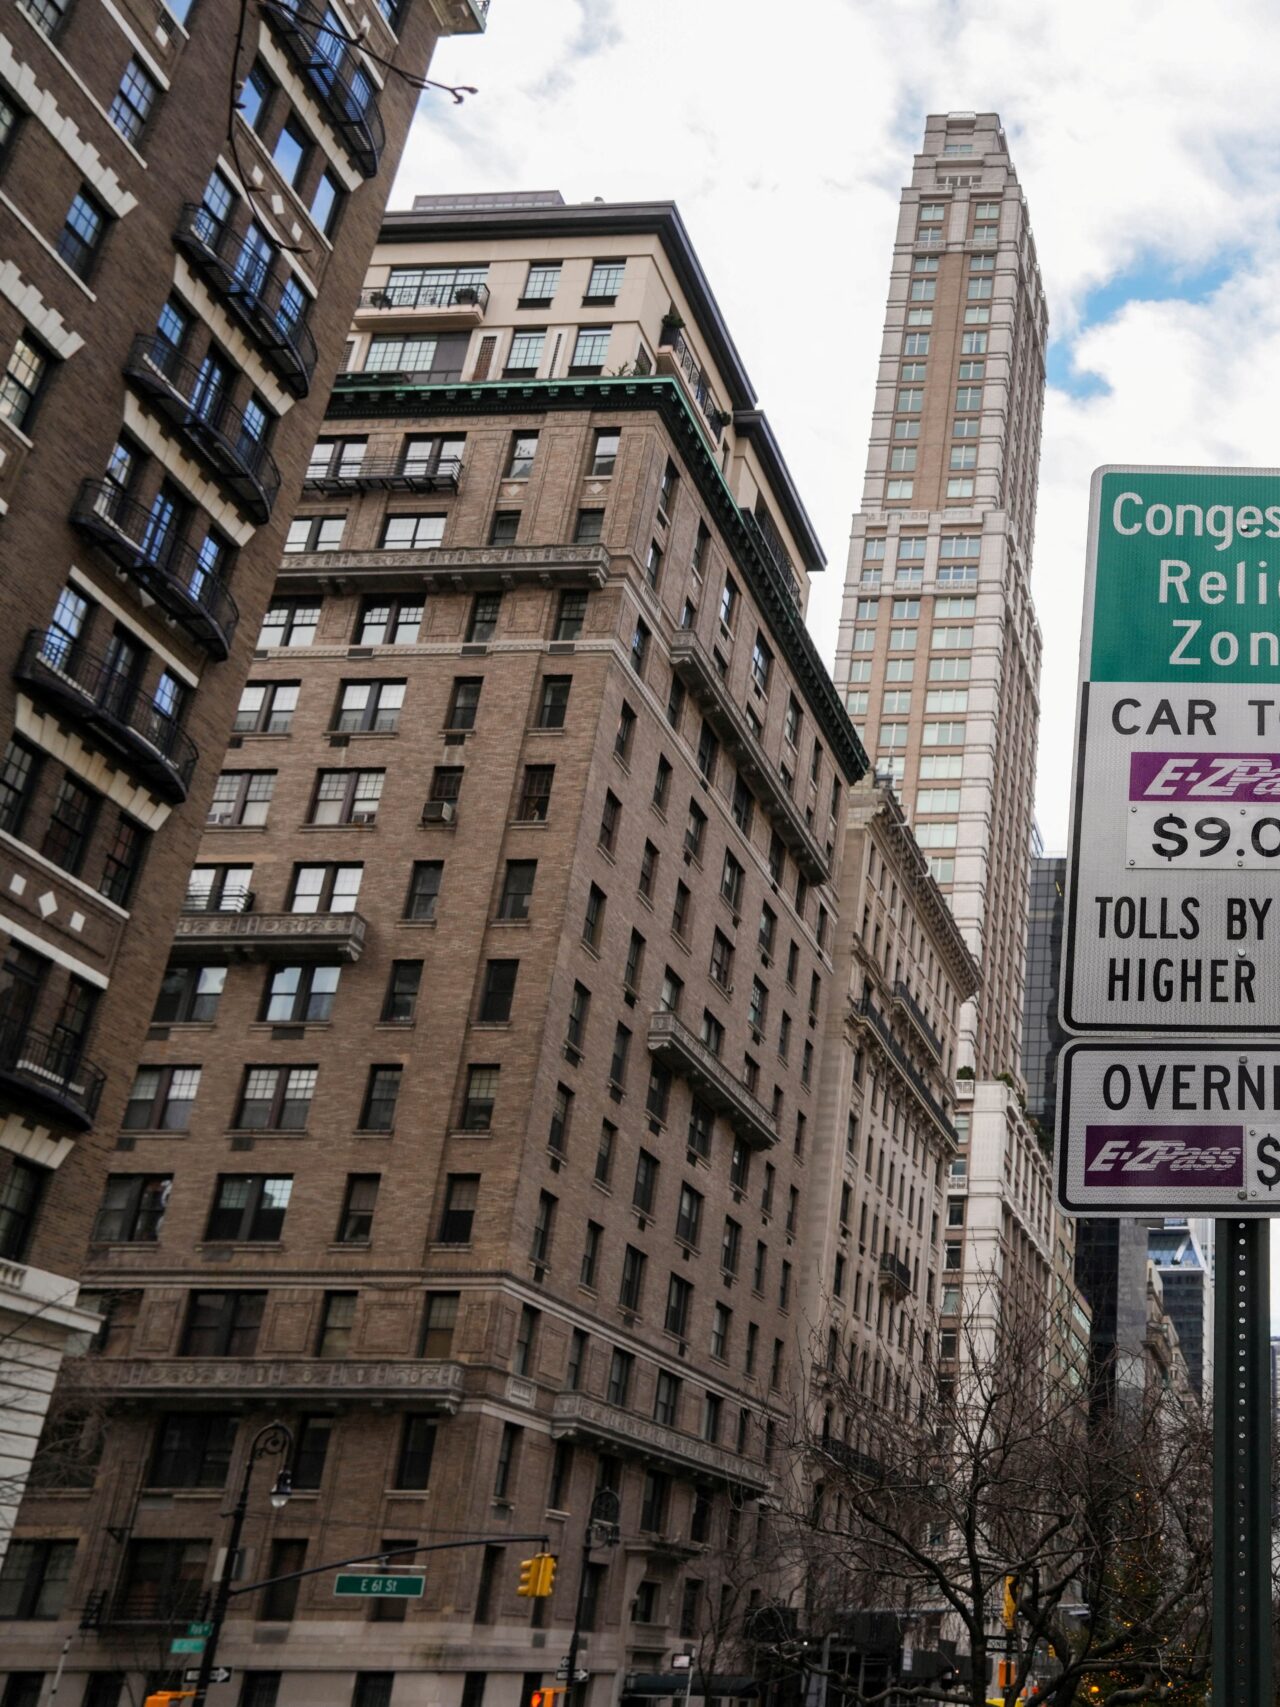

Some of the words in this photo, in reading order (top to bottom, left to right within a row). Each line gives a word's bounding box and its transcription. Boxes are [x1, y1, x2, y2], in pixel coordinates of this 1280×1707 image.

[1111, 698, 1217, 736] CAR
[1095, 896, 1201, 940] TOLLS
[1226, 898, 1273, 941] BY
[1107, 957, 1256, 1003] HIGHER
[1087, 1139, 1242, 1172] E-ZPass
[361, 1579, 369, 1592] E
[371, 1579, 383, 1592] 61
[385, 1579, 398, 1593] St
